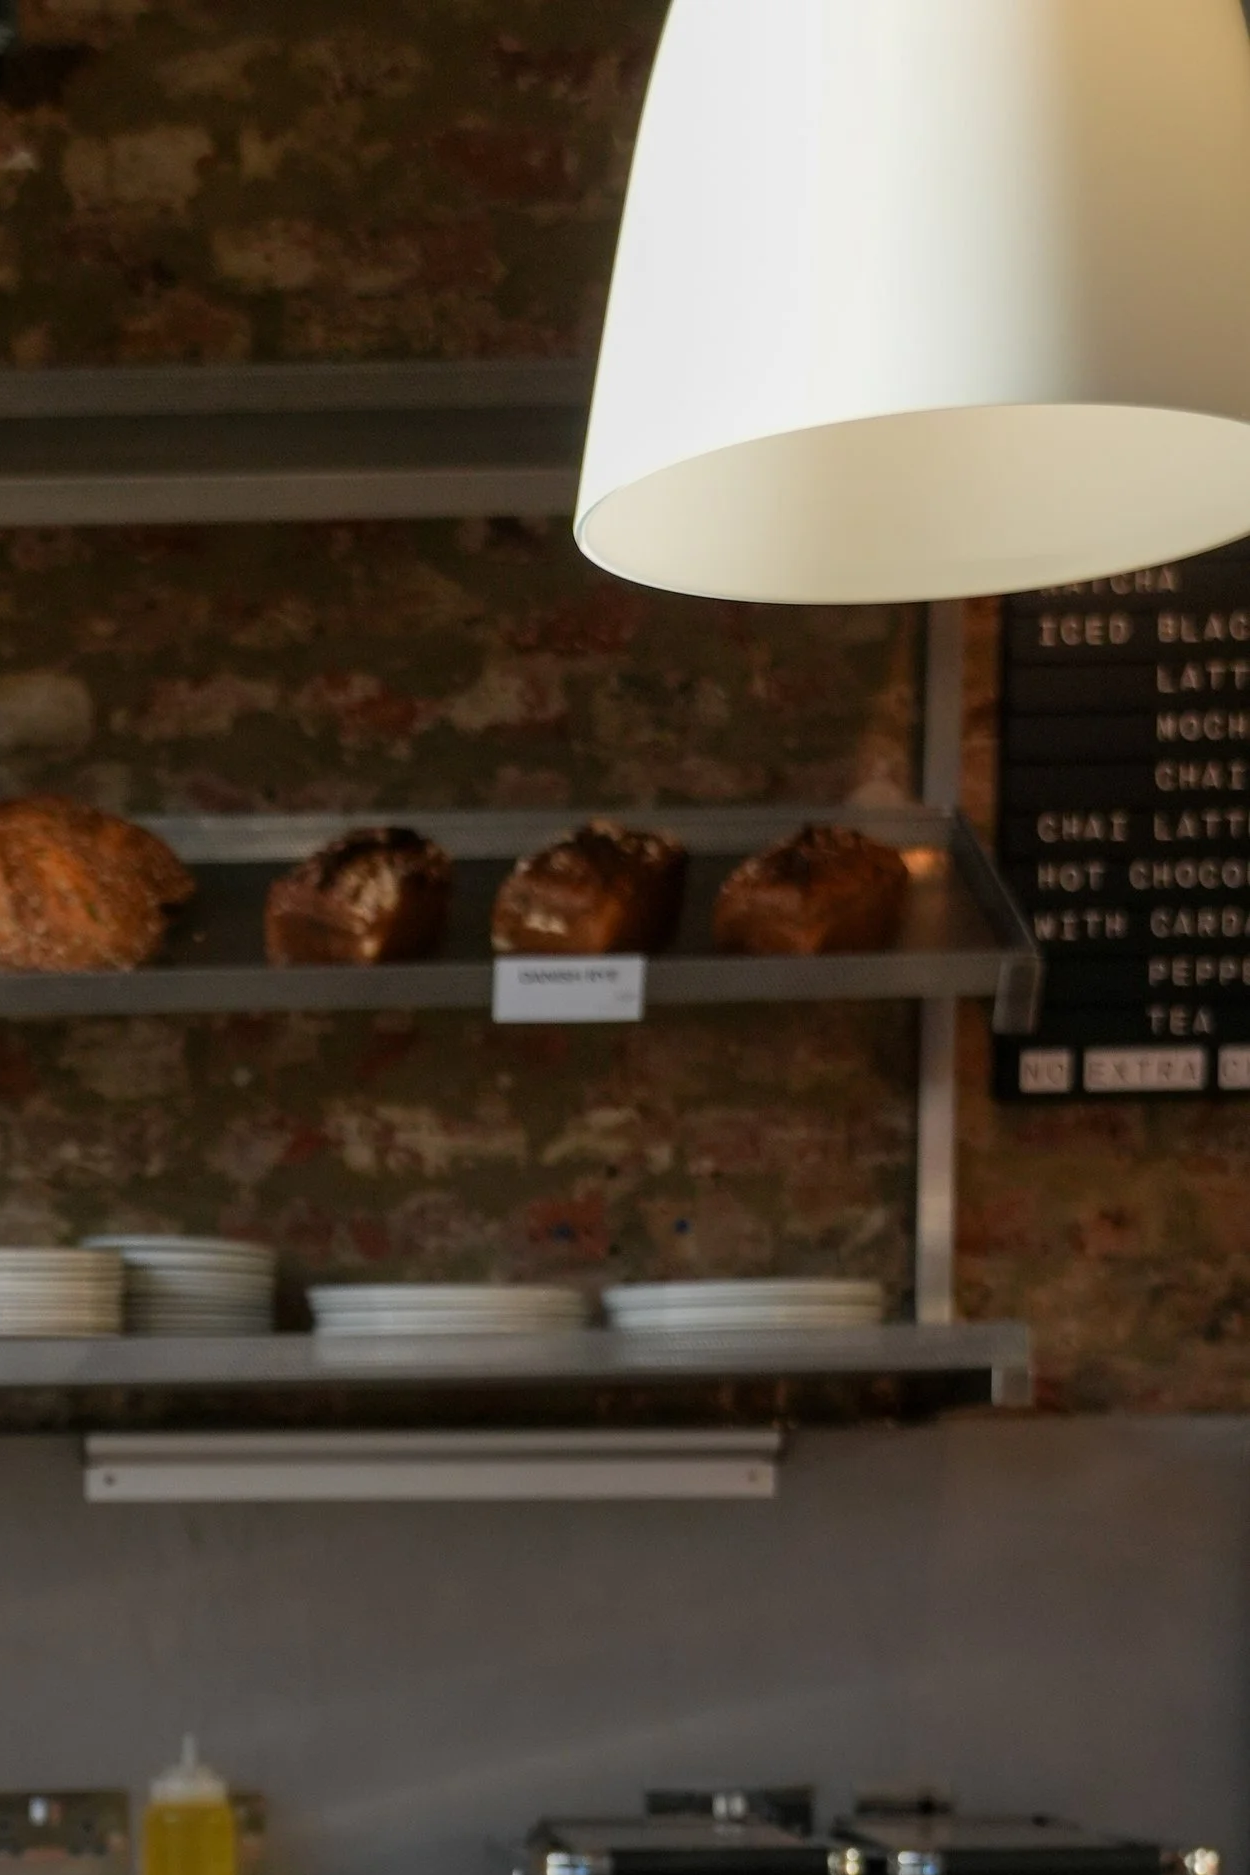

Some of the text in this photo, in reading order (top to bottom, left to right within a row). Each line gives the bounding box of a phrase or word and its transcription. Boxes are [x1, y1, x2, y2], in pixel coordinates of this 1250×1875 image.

[1039, 613, 1133, 647] ICED
[1154, 759, 1246, 792] CHAI
[1037, 808, 1250, 844] CHAI LATT
[1037, 857, 1250, 893] HOT CHOCO
[1034, 906, 1250, 942] WITH CARD
[1147, 1003, 1214, 1037] TEA
